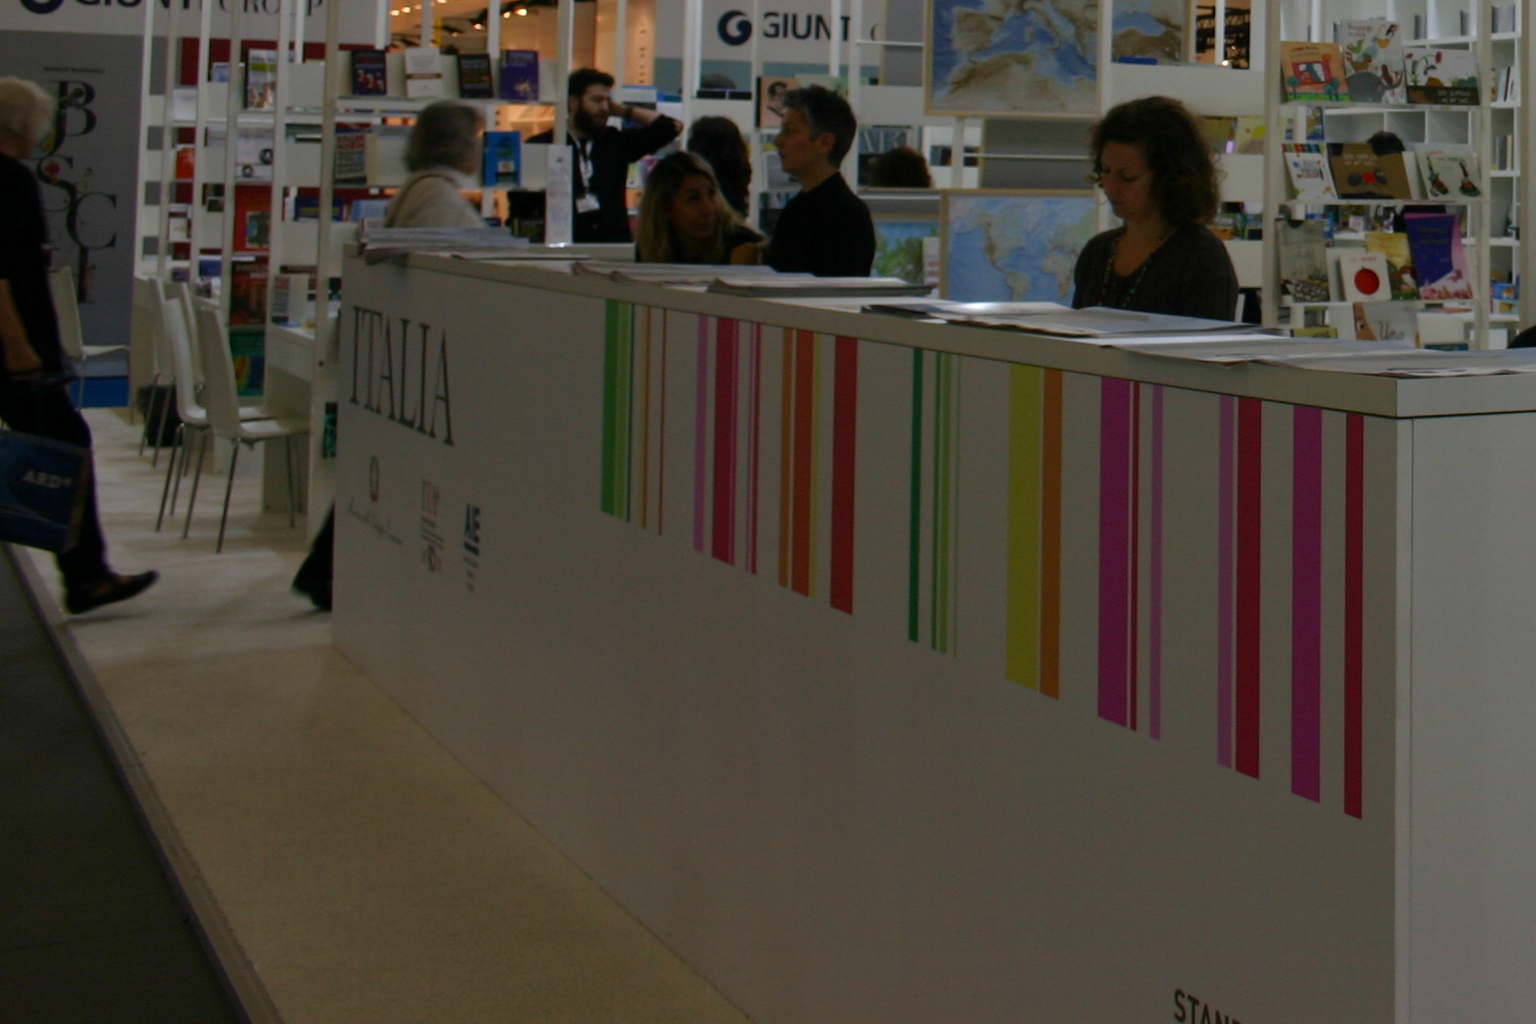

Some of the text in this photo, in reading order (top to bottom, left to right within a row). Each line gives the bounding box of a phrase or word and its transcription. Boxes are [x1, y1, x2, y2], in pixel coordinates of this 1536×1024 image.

[763, 11, 851, 42] GIUNT
[350, 306, 454, 447] ITALIA
[1174, 988, 1243, 1024] STA
